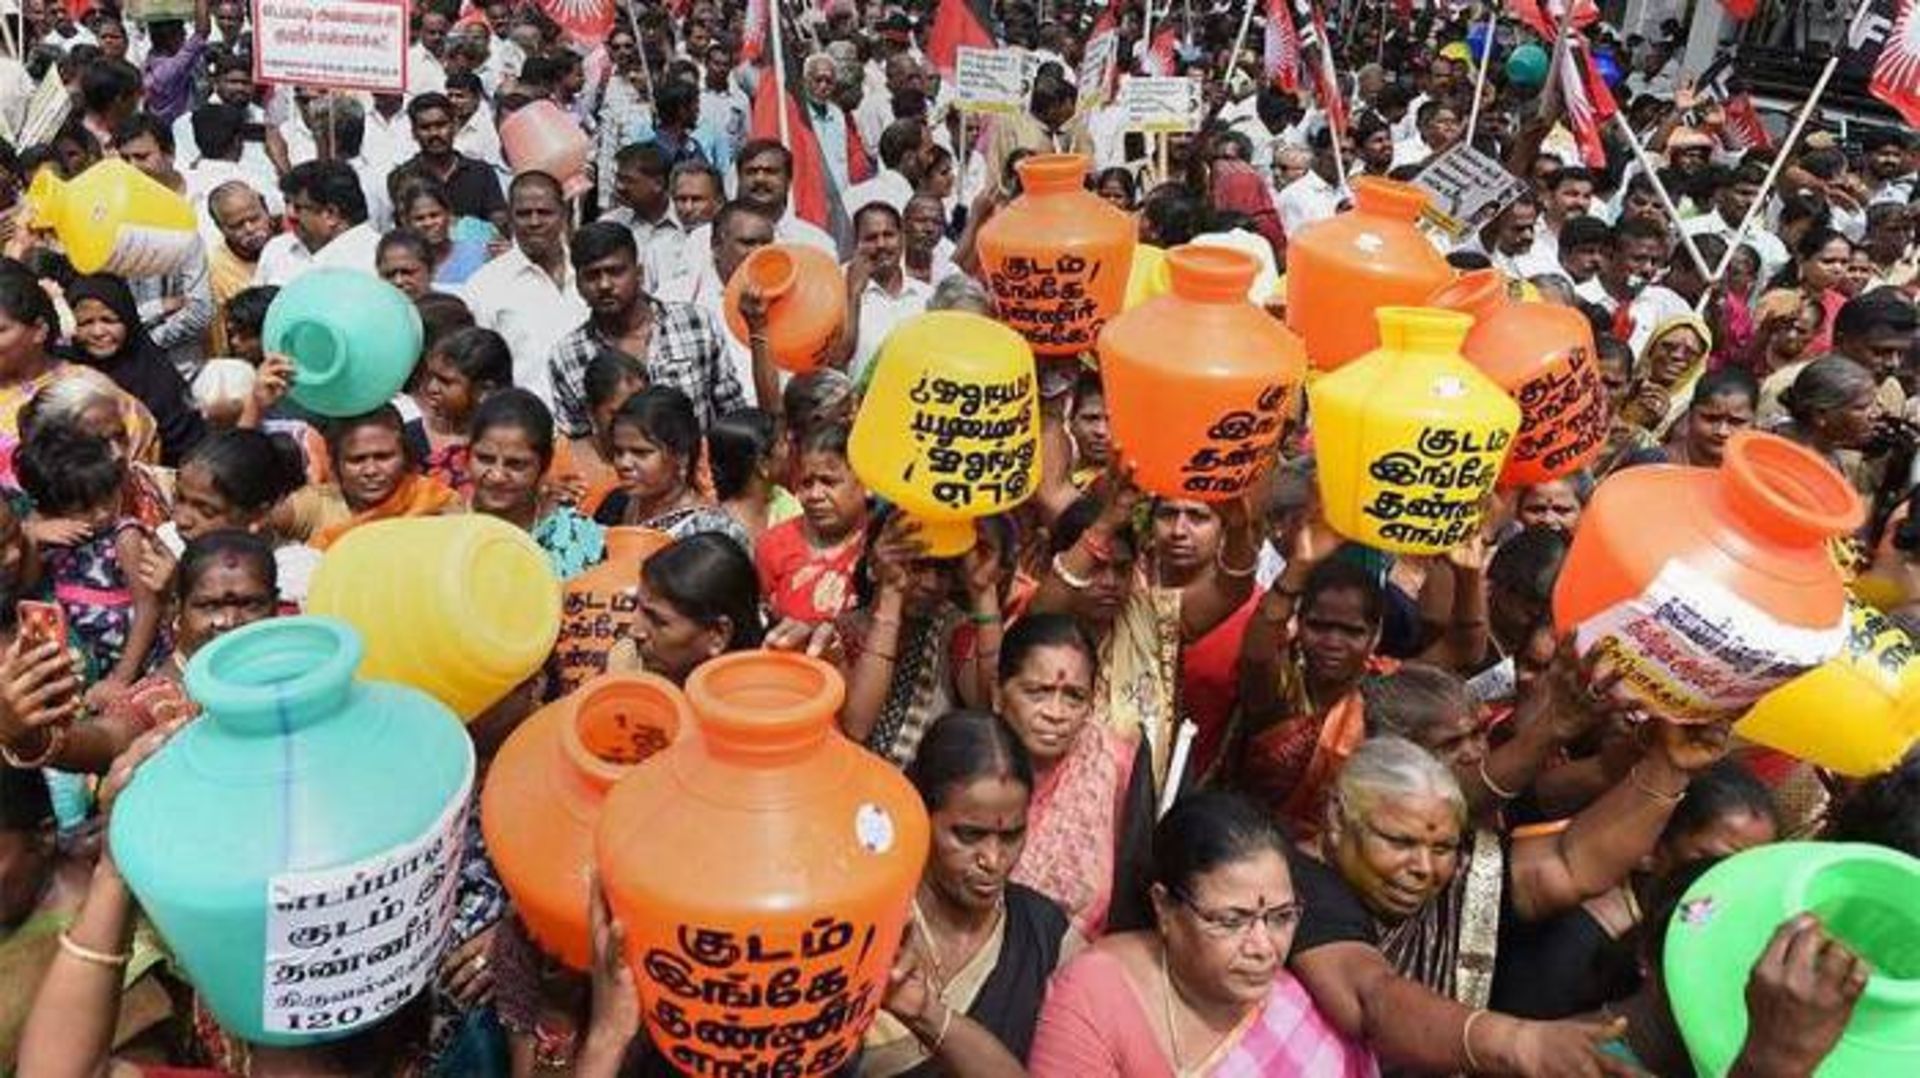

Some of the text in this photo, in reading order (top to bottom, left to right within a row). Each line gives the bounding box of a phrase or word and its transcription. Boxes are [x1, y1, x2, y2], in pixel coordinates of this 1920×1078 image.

[288, 896, 404, 949] குடம்
[677, 916, 853, 968] குடம்
[644, 948, 849, 1008] இங்கே
[287, 1006, 363, 1030] 120
